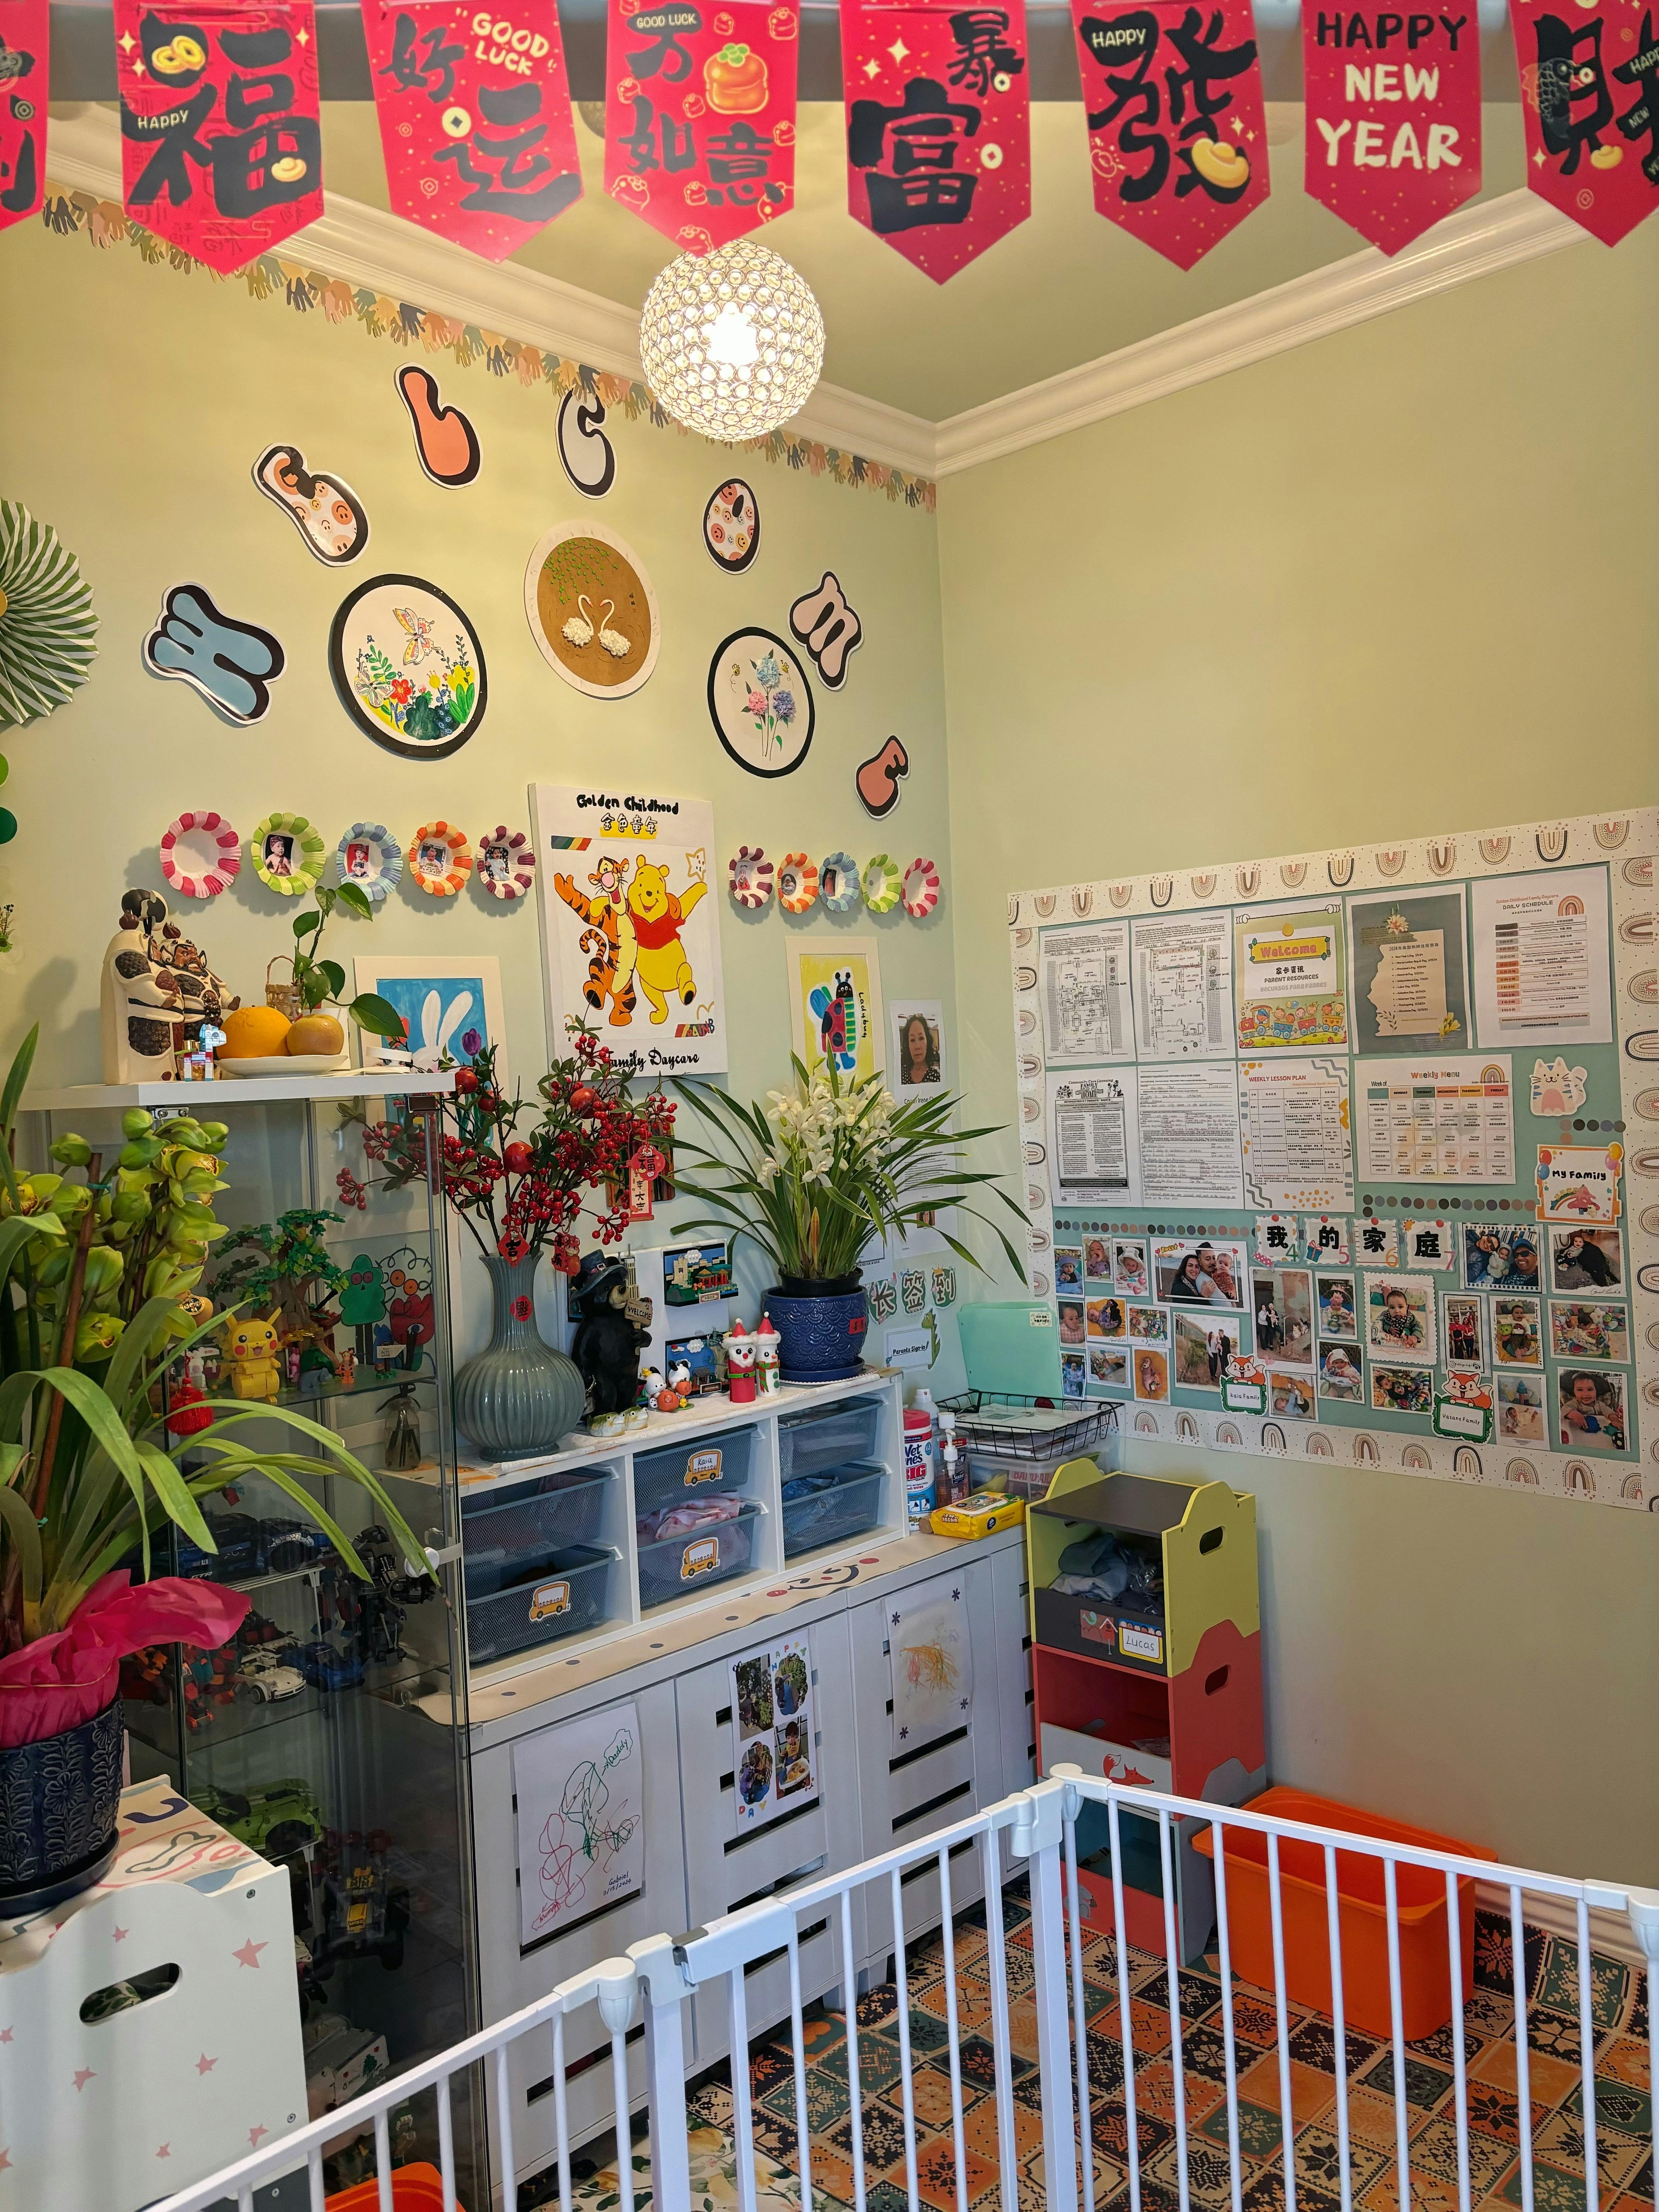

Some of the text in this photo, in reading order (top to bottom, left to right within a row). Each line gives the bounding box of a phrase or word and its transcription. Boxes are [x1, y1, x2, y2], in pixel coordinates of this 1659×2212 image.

[636, 13, 697, 28] GOOD LUCK
[472, 12, 549, 58] GOOD
[1092, 29, 1146, 48] HAPPY
[1317, 12, 1467, 51] HAPPY
[475, 40, 534, 76] LUCK
[1345, 63, 1439, 102] NEW
[119, 10, 322, 219] 福
[137, 109, 189, 130] HAPPY
[616, 95, 784, 206] 如意
[1316, 117, 1462, 170] YEAR
[577, 794, 679, 815] Golden Childhood
[601, 813, 658, 835] 金色童年
[1522, 900, 1553, 908] SCHEDULE
[1261, 945, 1317, 958] Welcome
[858, 992, 869, 1038] Ladybug
[610, 1047, 699, 1072] amily Daycare
[1411, 1071, 1438, 1079] Weekly
[1553, 1170, 1606, 1181] My Family
[1266, 1225, 1442, 1258] 我的家庭
[627, 1306, 651, 1321] WELCOME
[893, 1347, 910, 1355] Parents
[1462, 1417, 1480, 1425] Family
[905, 1453, 923, 1465] nes
[609, 1739, 629, 1764] Daddy
[738, 1800, 767, 1818] DAY
[609, 1871, 629, 1886] Gabriel
